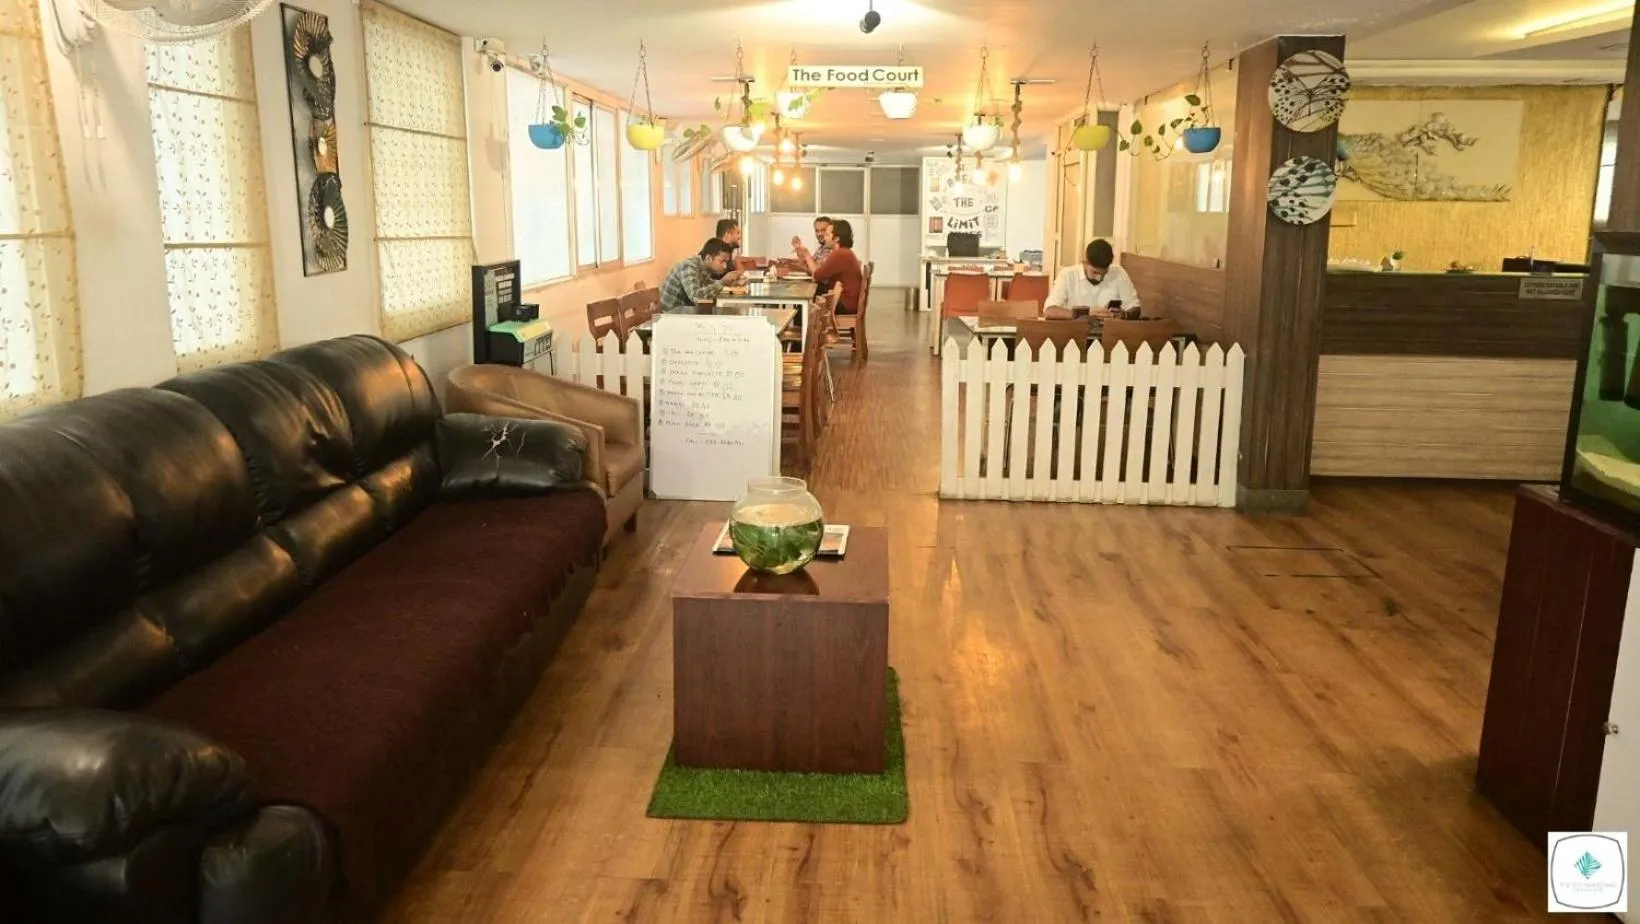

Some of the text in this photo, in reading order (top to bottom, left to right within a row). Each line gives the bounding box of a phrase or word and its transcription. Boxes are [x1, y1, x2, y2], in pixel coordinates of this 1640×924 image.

[792, 68, 919, 82] The Food Court
[953, 197, 975, 209] THE
